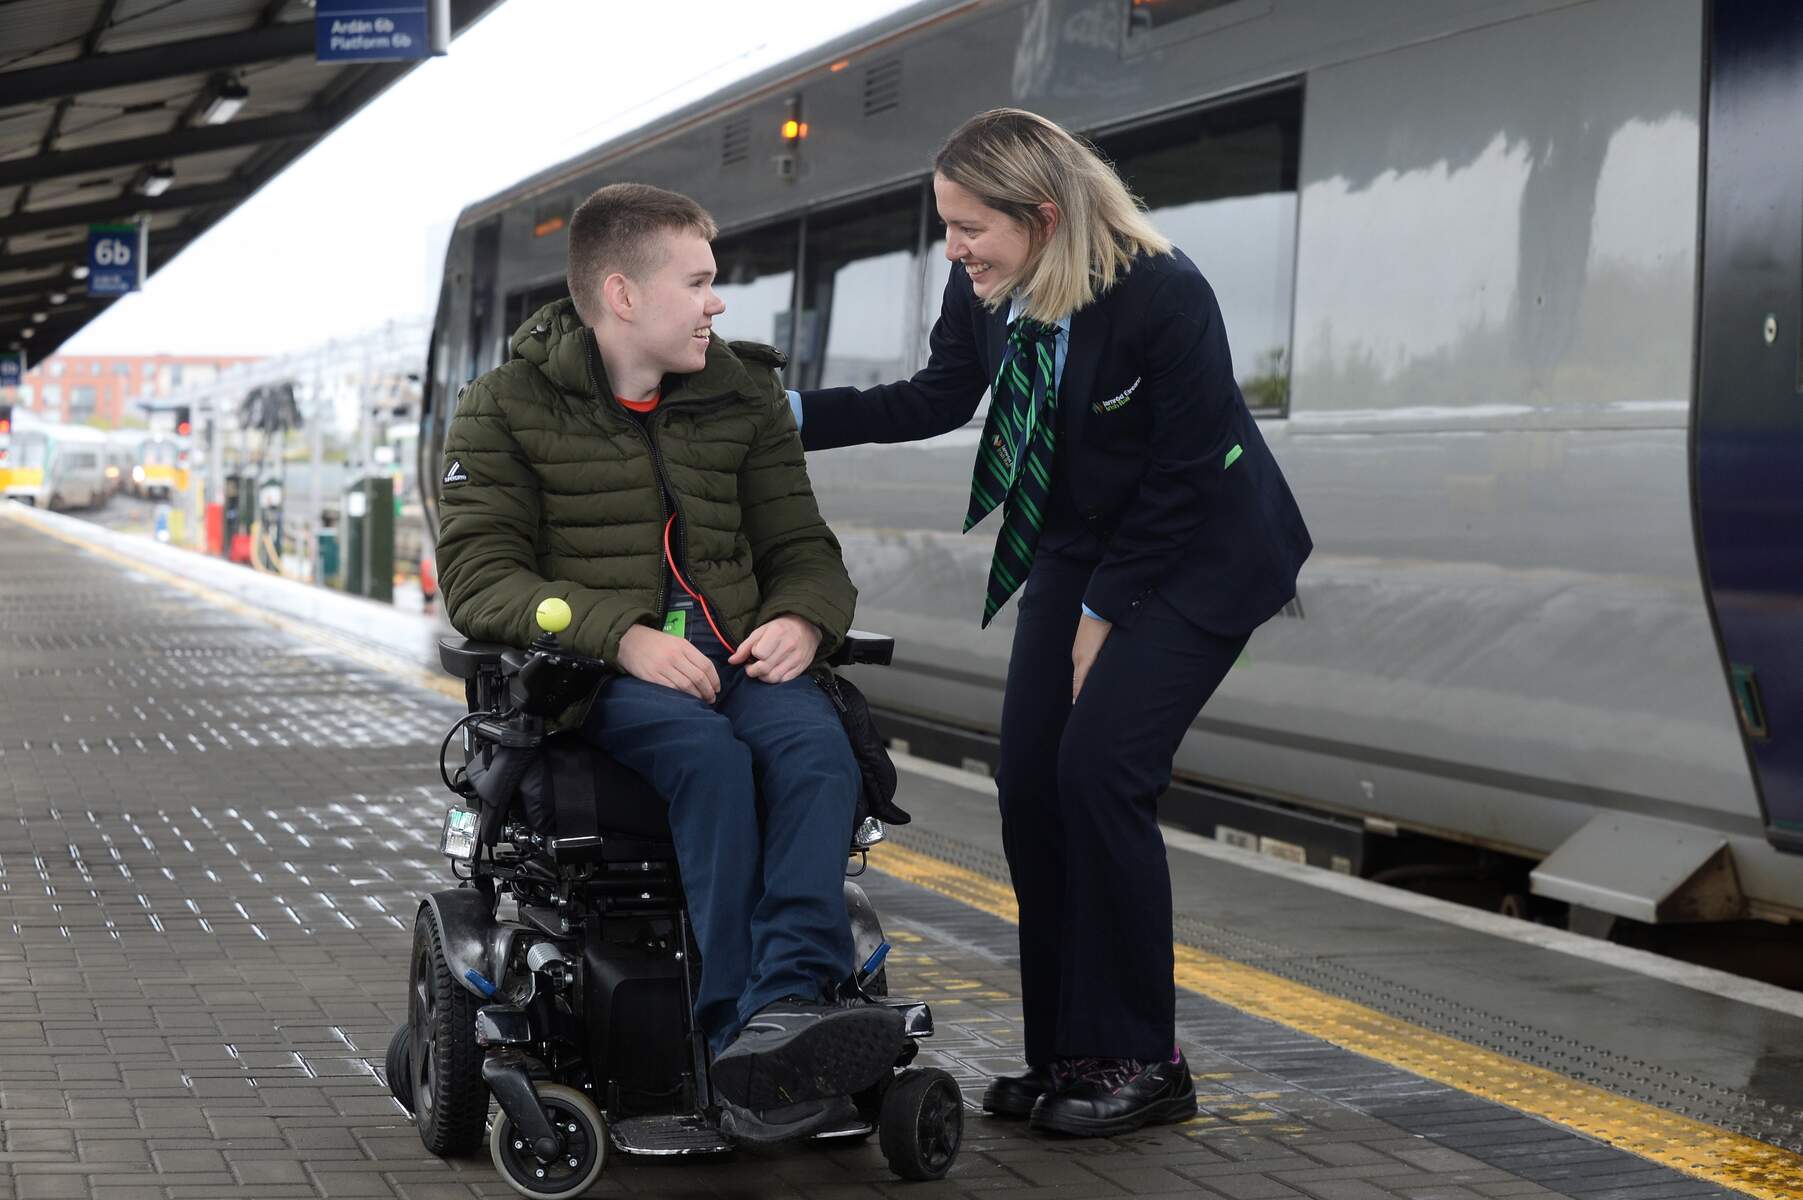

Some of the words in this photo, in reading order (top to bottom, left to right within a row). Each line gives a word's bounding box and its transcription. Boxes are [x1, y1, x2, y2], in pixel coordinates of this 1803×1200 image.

[374, 17, 395, 33] 6b
[330, 34, 390, 50] Platform
[391, 32, 412, 48] 6b
[95, 238, 131, 266] 6b
